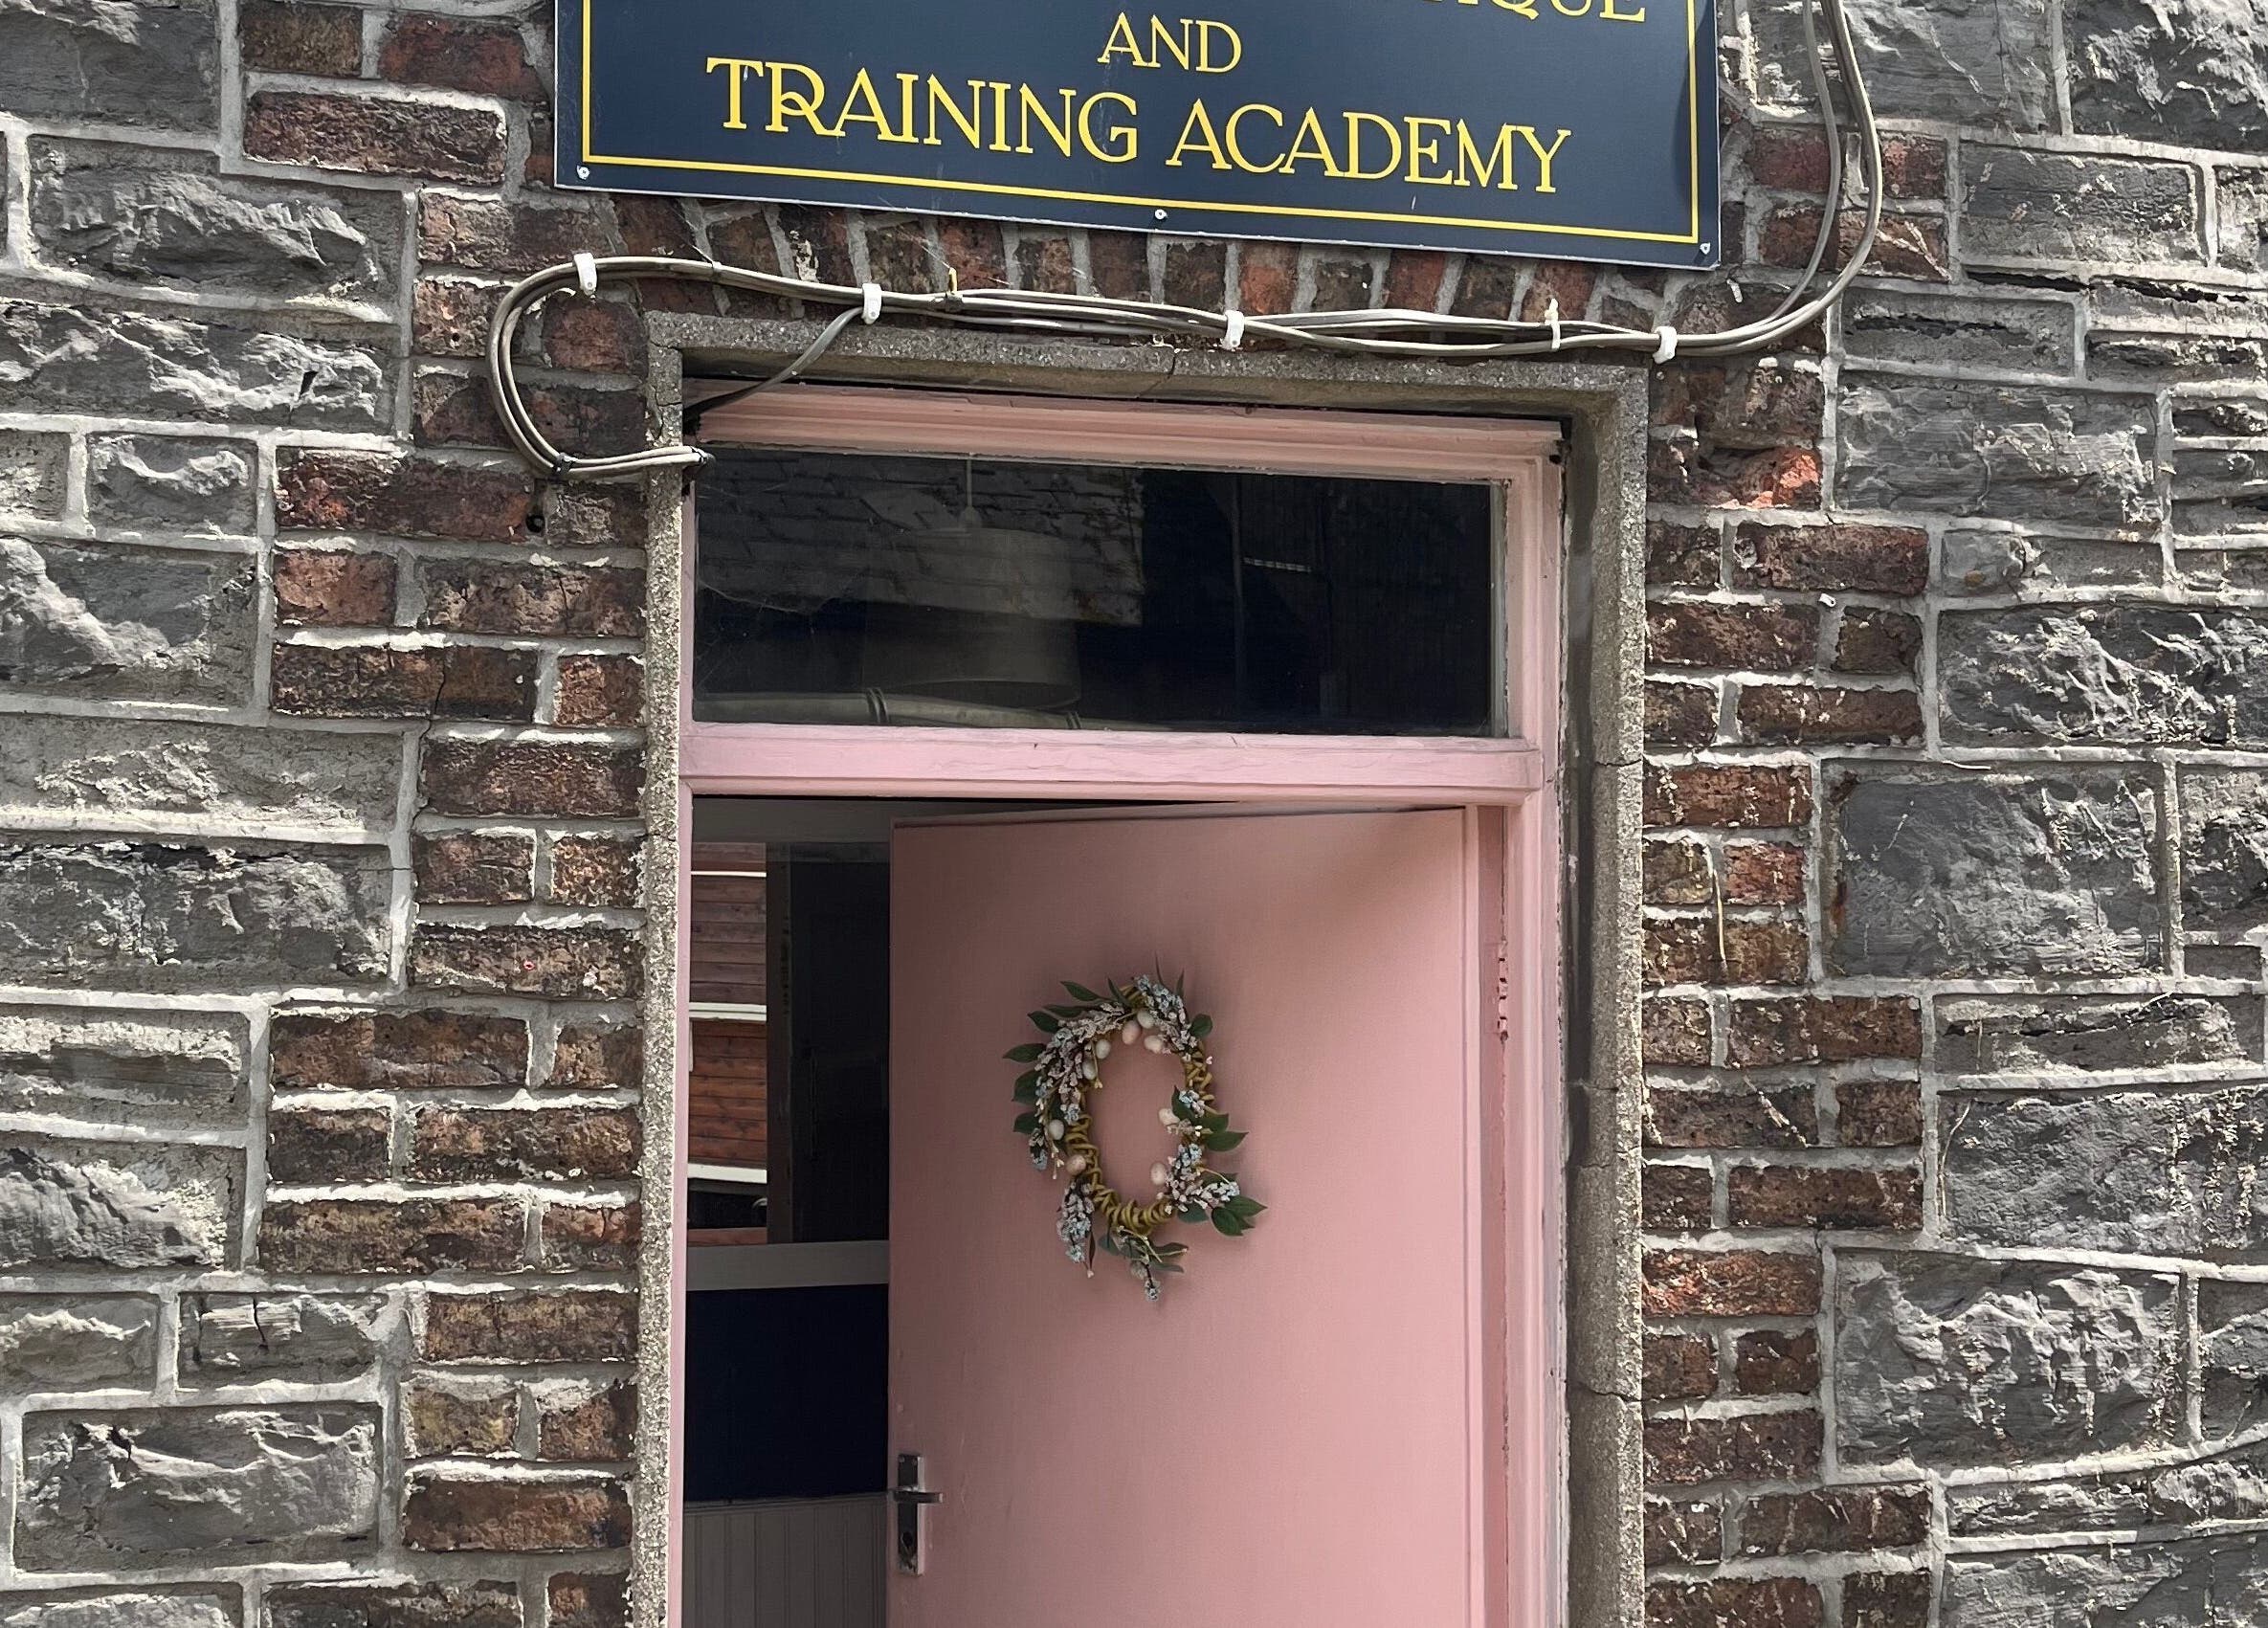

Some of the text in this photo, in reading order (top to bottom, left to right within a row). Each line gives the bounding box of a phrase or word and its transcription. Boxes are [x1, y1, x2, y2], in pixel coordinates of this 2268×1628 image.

[1098, 12, 1242, 74] AND
[706, 56, 1572, 193] TRAINING ACADEMY
